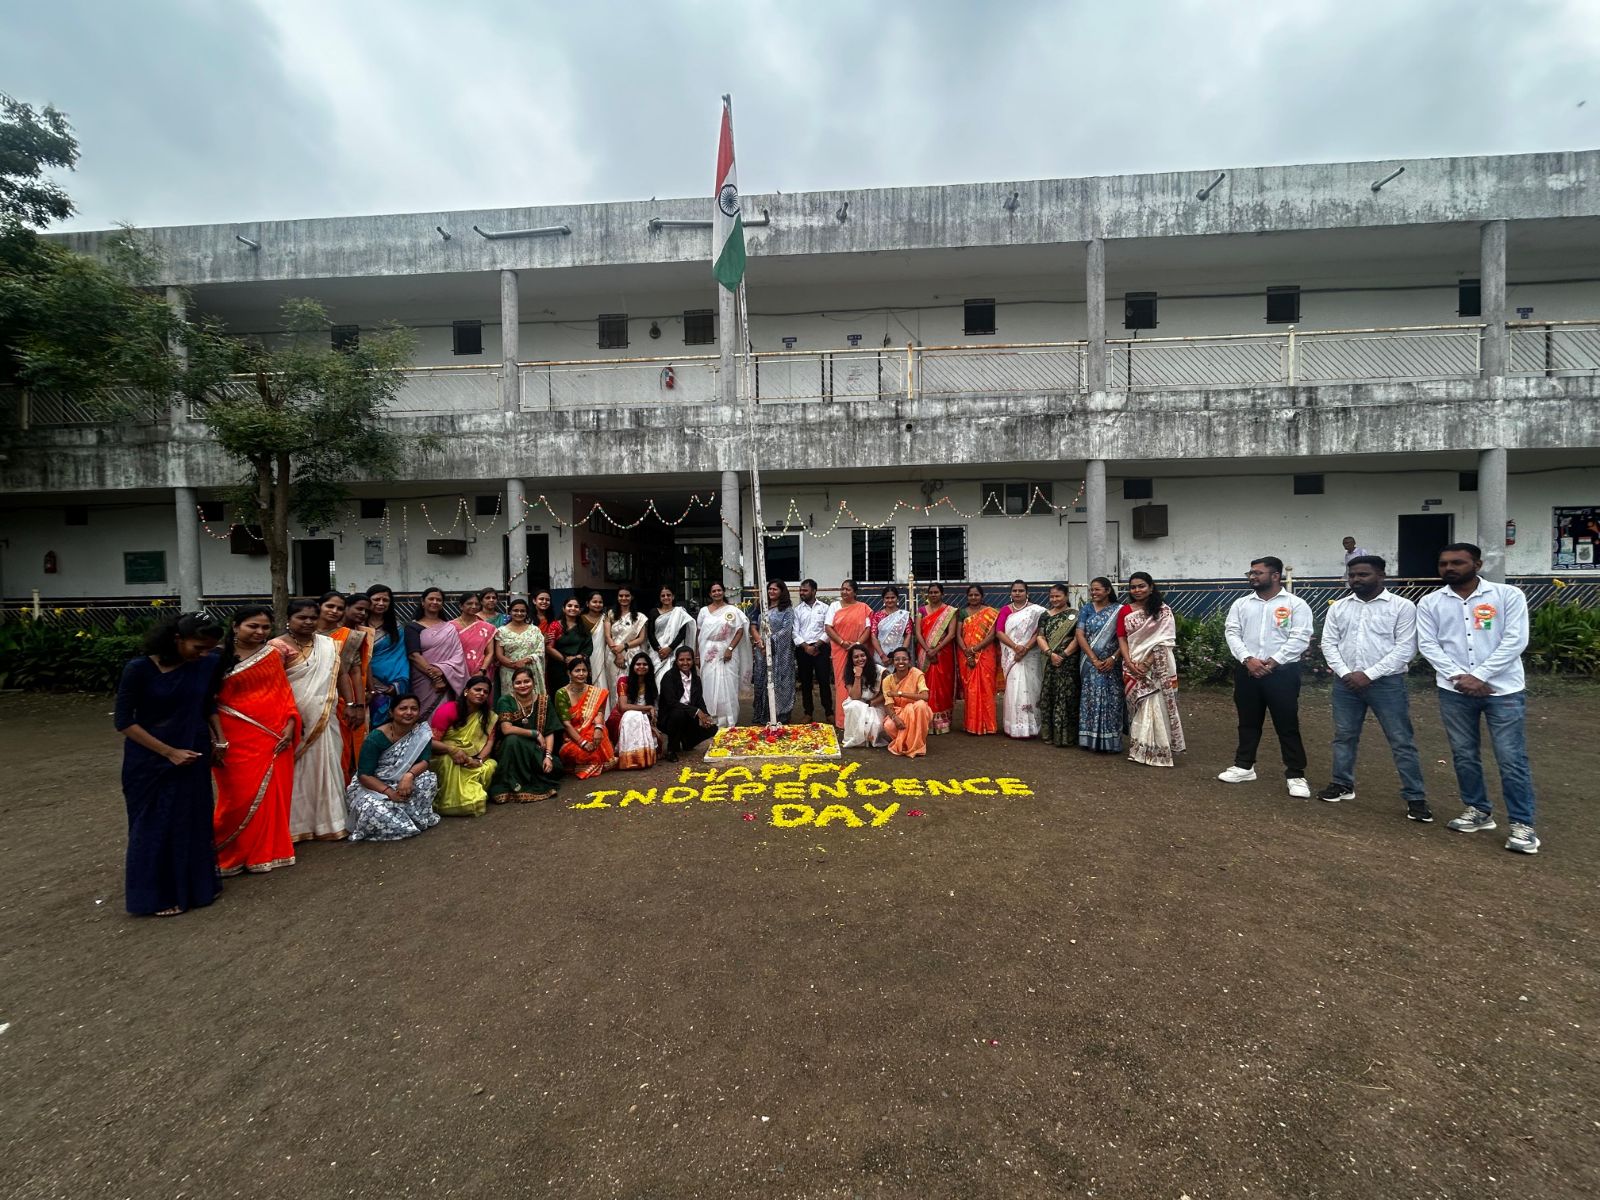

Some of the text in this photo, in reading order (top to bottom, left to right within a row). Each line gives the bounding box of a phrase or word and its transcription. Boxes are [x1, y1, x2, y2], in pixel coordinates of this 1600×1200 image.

[677, 762, 860, 783] HAPPY
[570, 776, 1034, 809] INDEPENDENCE
[769, 802, 900, 828] DAY
